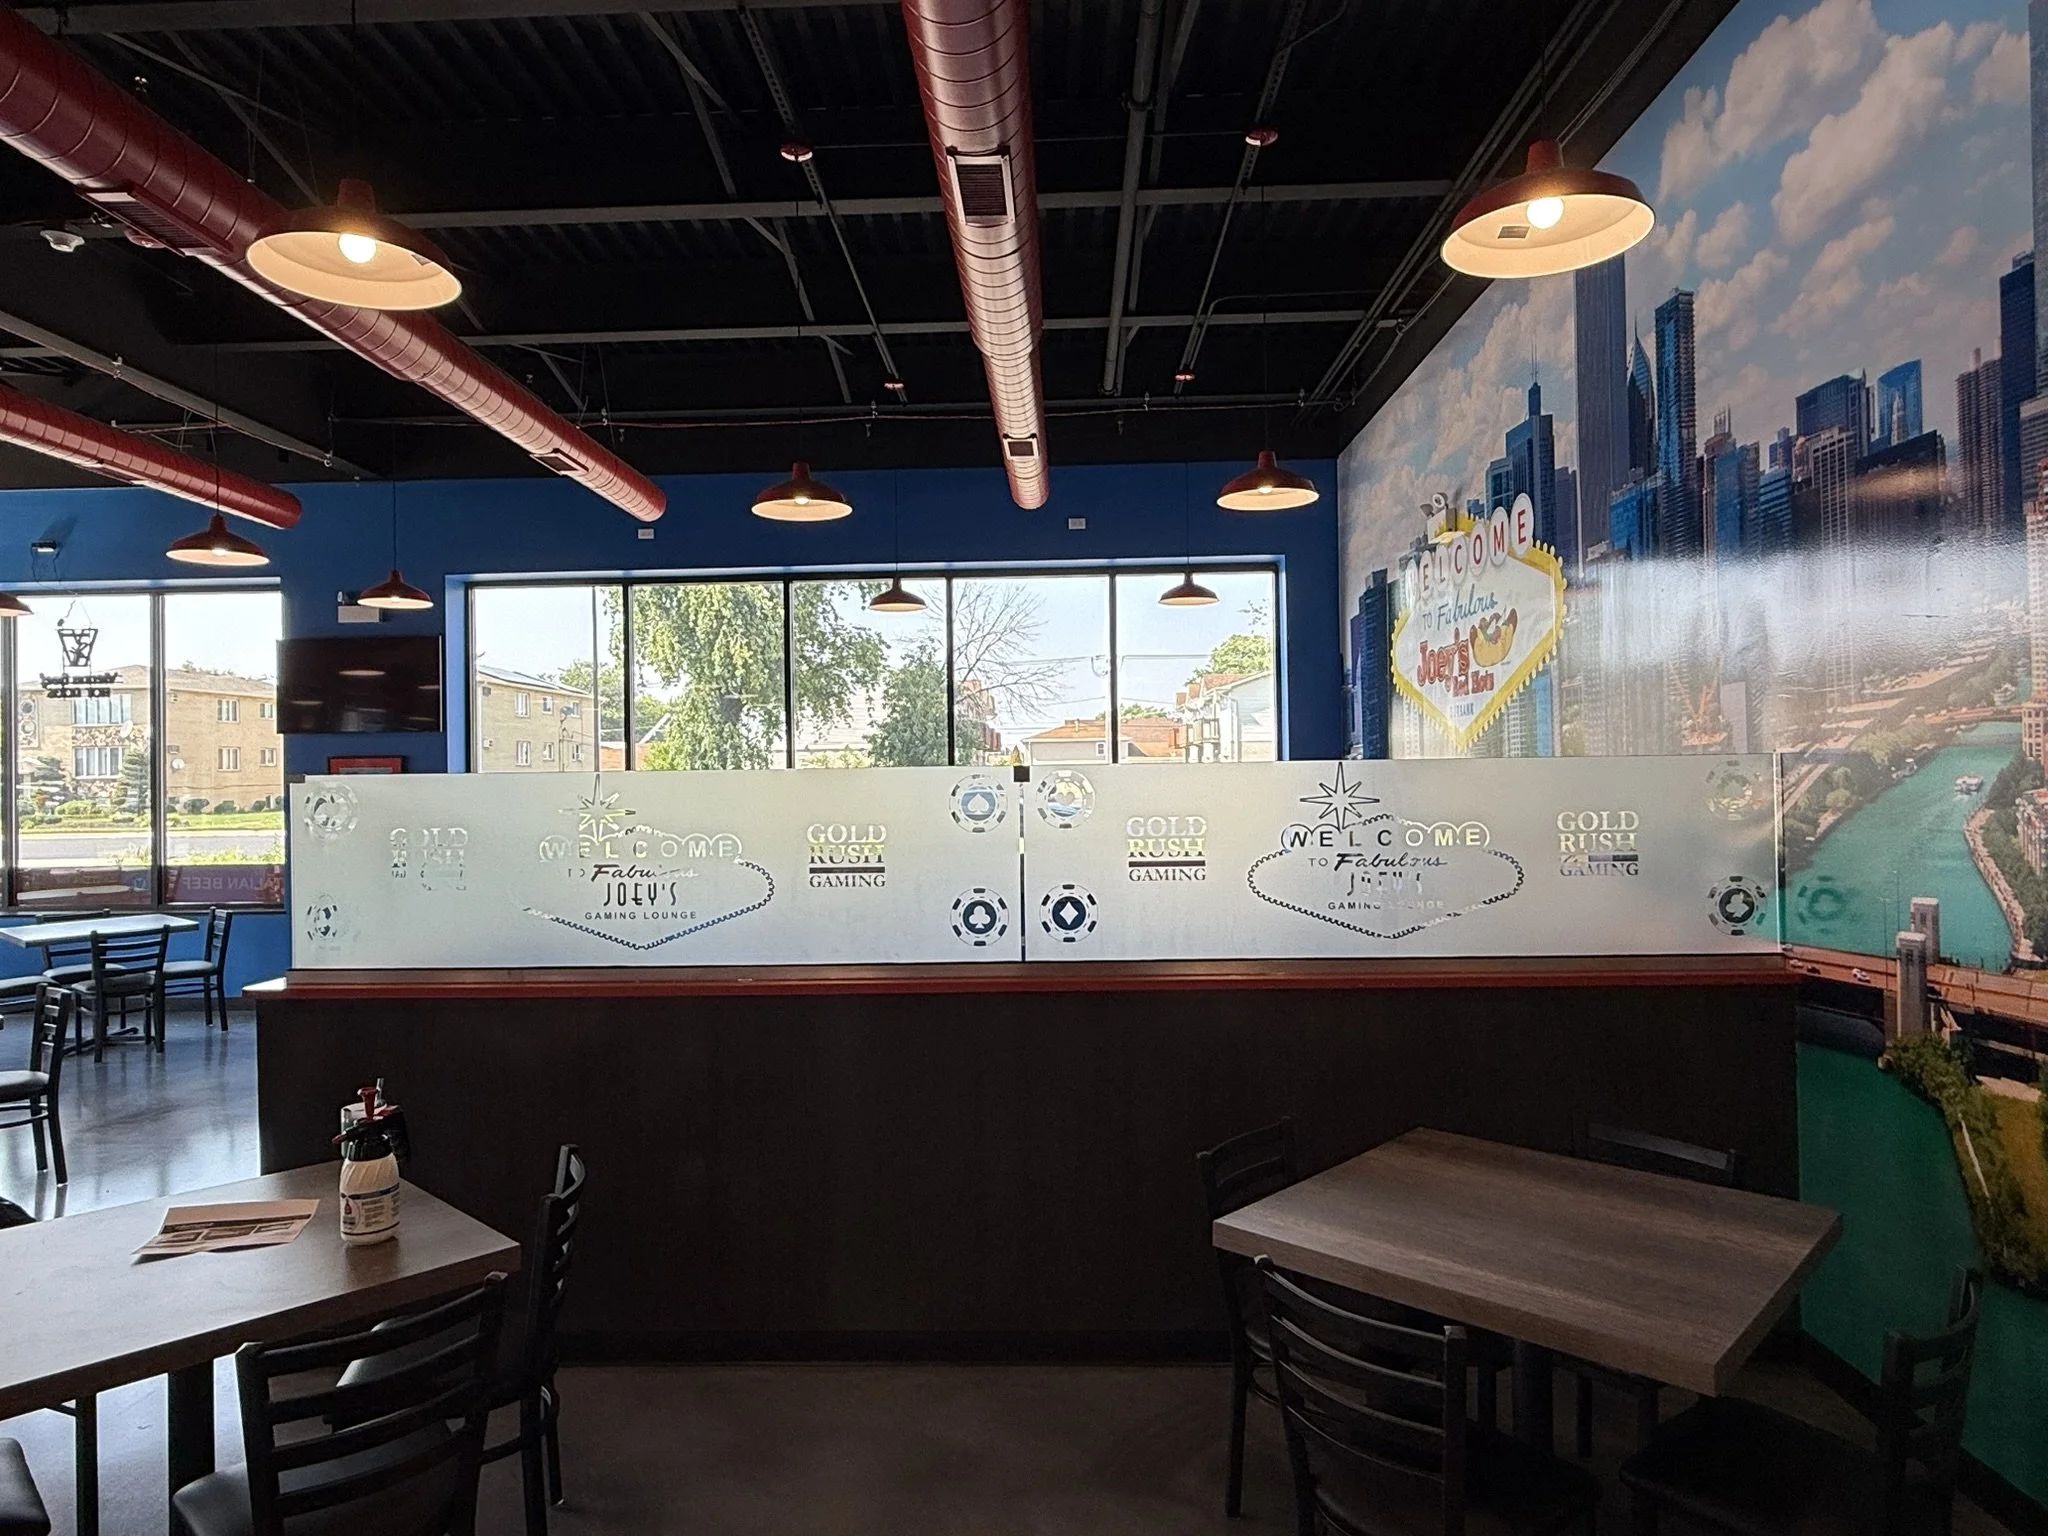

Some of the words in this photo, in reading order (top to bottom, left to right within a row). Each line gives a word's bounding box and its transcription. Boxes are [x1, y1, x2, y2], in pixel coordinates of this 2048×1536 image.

[1407, 509, 1526, 599] ELCOME
[1422, 614, 1432, 631] TO
[1437, 583, 1498, 631] Fabulous
[1417, 627, 1470, 692] Joey's
[1126, 815, 1208, 838] GOLD
[1557, 810, 1640, 831] GOLD
[806, 823, 887, 845] GOLD
[1289, 828, 1481, 848] WELCOME
[1558, 832, 1638, 853] RUSH
[545, 840, 733, 859] WELCOME
[807, 844, 886, 864] RUSH
[1127, 838, 1206, 859] RUSH
[1310, 857, 1329, 867] TO
[1559, 862, 1640, 877] GAMING
[590, 864, 700, 882] Fabuus
[809, 874, 887, 888] GAMING
[1128, 867, 1207, 882] GAMING
[1347, 871, 1424, 896] JOEYS
[603, 882, 677, 907] JOEY'S
[584, 911, 637, 920] GAMING
[643, 910, 697, 920] LOUNGE
